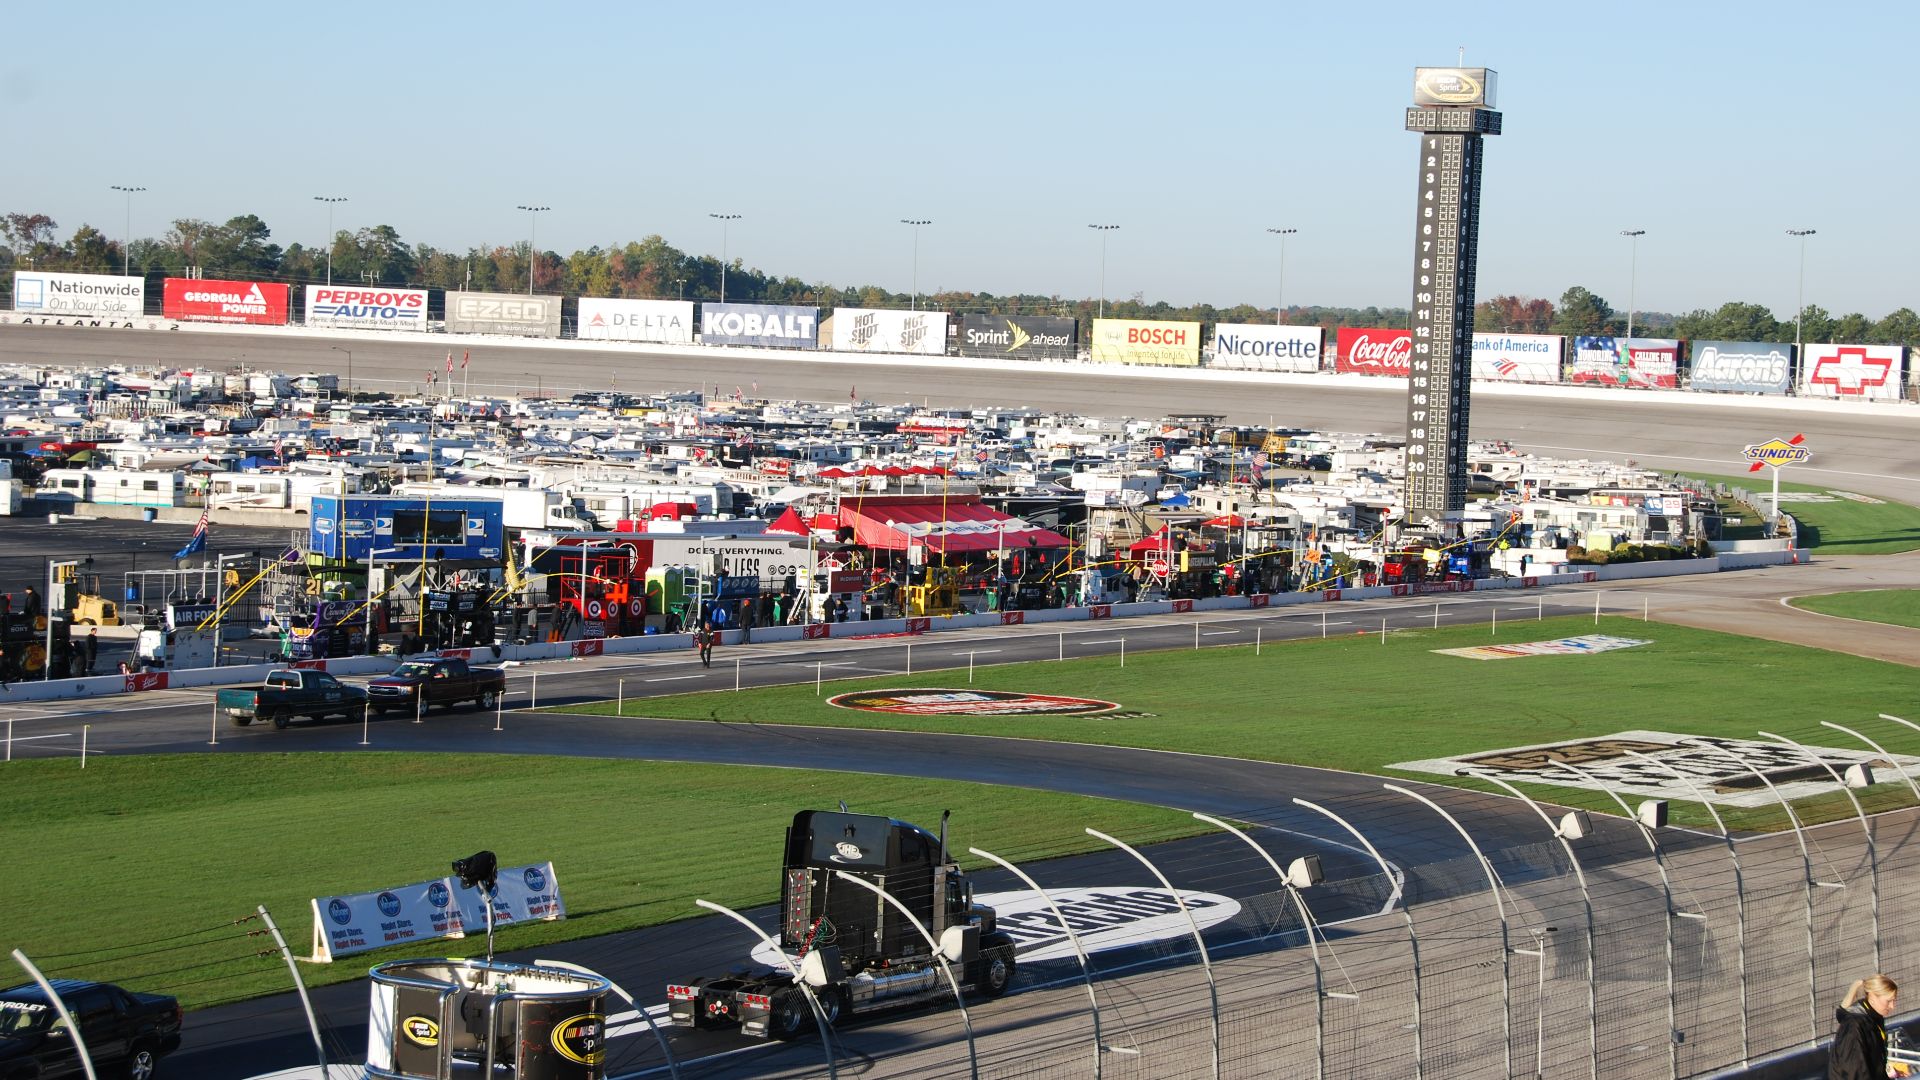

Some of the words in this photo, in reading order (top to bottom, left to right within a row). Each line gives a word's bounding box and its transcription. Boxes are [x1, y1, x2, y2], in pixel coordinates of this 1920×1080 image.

[1430, 139, 1435, 149] 1
[1428, 156, 1435, 166] 2
[1426, 173, 1434, 183] 3
[1425, 191, 1433, 200] 4
[1425, 208, 1432, 217] 5
[1424, 225, 1432, 234] 6
[1423, 242, 1430, 251] 7
[1422, 259, 1430, 268] 8
[1421, 276, 1429, 285] 9
[50, 280, 140, 296] Nationwide
[184, 292, 241, 303] GEORGIA
[316, 290, 422, 307] PEPBOYS
[1417, 293, 1431, 302] 10
[50, 298, 67, 309] On
[72, 299, 98, 311] Your
[103, 300, 127, 312] Side
[222, 304, 266, 314] POWER
[334, 305, 398, 318] AUTO
[1418, 310, 1429, 319] 11
[22, 317, 134, 329] ATLANTA
[614, 314, 680, 328] DELTA
[704, 312, 814, 338] KOBALT
[854, 312, 875, 328] HOT
[852, 324, 879, 344] SHOT
[900, 326, 928, 346] SHOT
[1128, 328, 1186, 345] BOSCH
[1416, 327, 1429, 336] 12
[967, 329, 1009, 347] Sprint
[1032, 334, 1069, 346] ahead
[1218, 334, 1316, 359] Nicorette
[1415, 344, 1428, 353] 13
[1472, 338, 1492, 350] ank
[1493, 338, 1504, 350] of
[1505, 338, 1549, 352] America
[1127, 350, 1160, 359] Invented
[1661, 352, 1672, 362] FOR
[1414, 361, 1428, 370] 14
[1693, 348, 1787, 385] Aaron's
[1413, 377, 1427, 387] 15
[1413, 394, 1426, 404] 16
[1412, 411, 1426, 421] 17
[1411, 428, 1424, 438] 18
[1750, 448, 1804, 458] SUNOCO
[1408, 462, 1424, 472] 20
[1188, 557, 1214, 566] ATERPILLAR
[1154, 564, 1168, 572] STOP
[306, 579, 320, 594] 21
[176, 612, 192, 622] AIR
[194, 610, 228, 622] FORE
